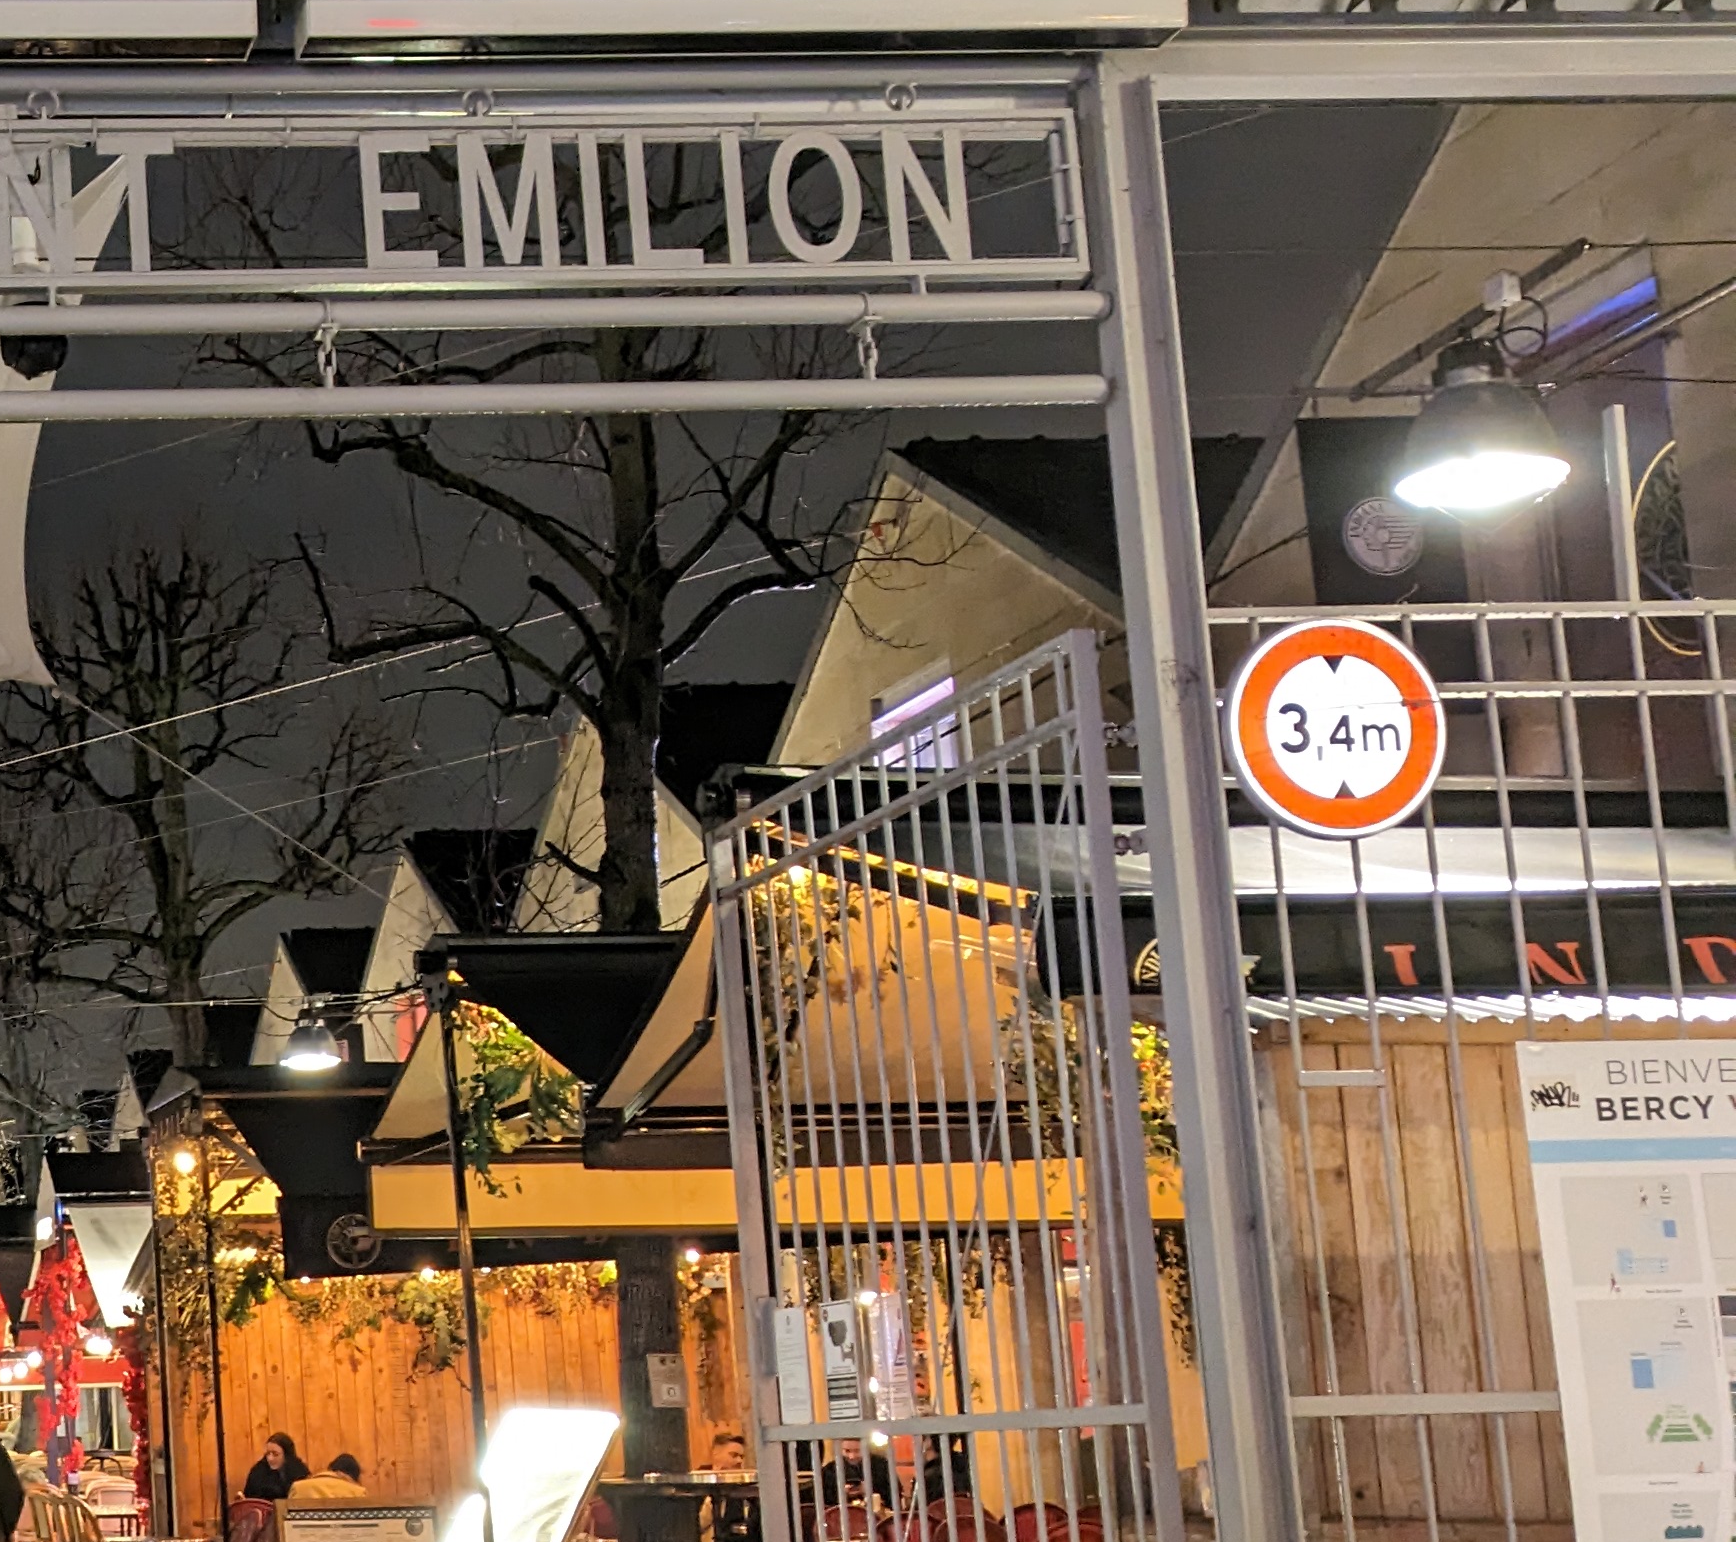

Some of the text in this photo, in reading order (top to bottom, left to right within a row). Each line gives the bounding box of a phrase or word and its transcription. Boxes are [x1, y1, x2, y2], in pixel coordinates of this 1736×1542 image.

[359, 130, 973, 268] EMILION
[1606, 1058, 1736, 1085] BIENVE
[1595, 1094, 1714, 1121] BERCY
